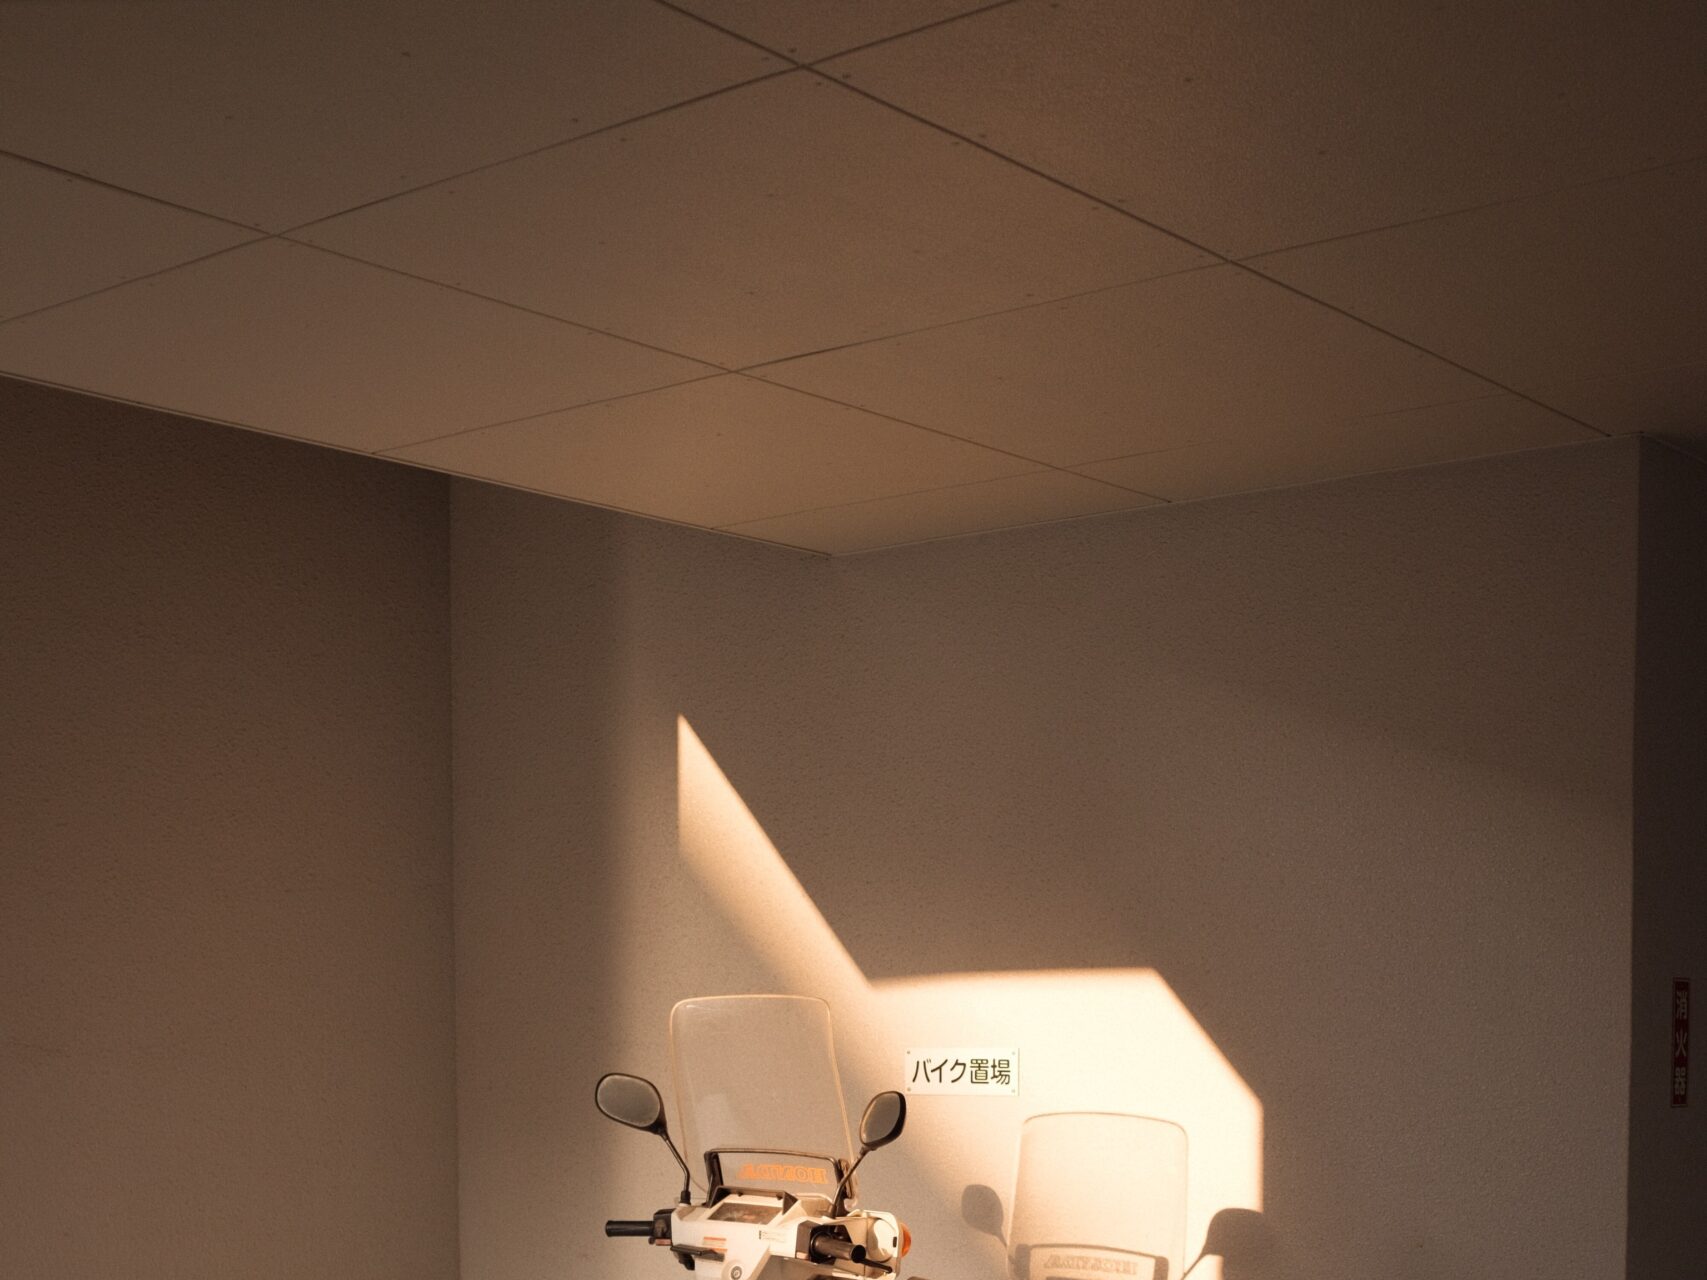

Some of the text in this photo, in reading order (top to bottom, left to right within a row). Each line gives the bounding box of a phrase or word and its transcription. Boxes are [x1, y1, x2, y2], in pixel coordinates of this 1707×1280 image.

[911, 1058, 1011, 1085] バイク置場
[1674, 991, 1688, 1096] 消火器
